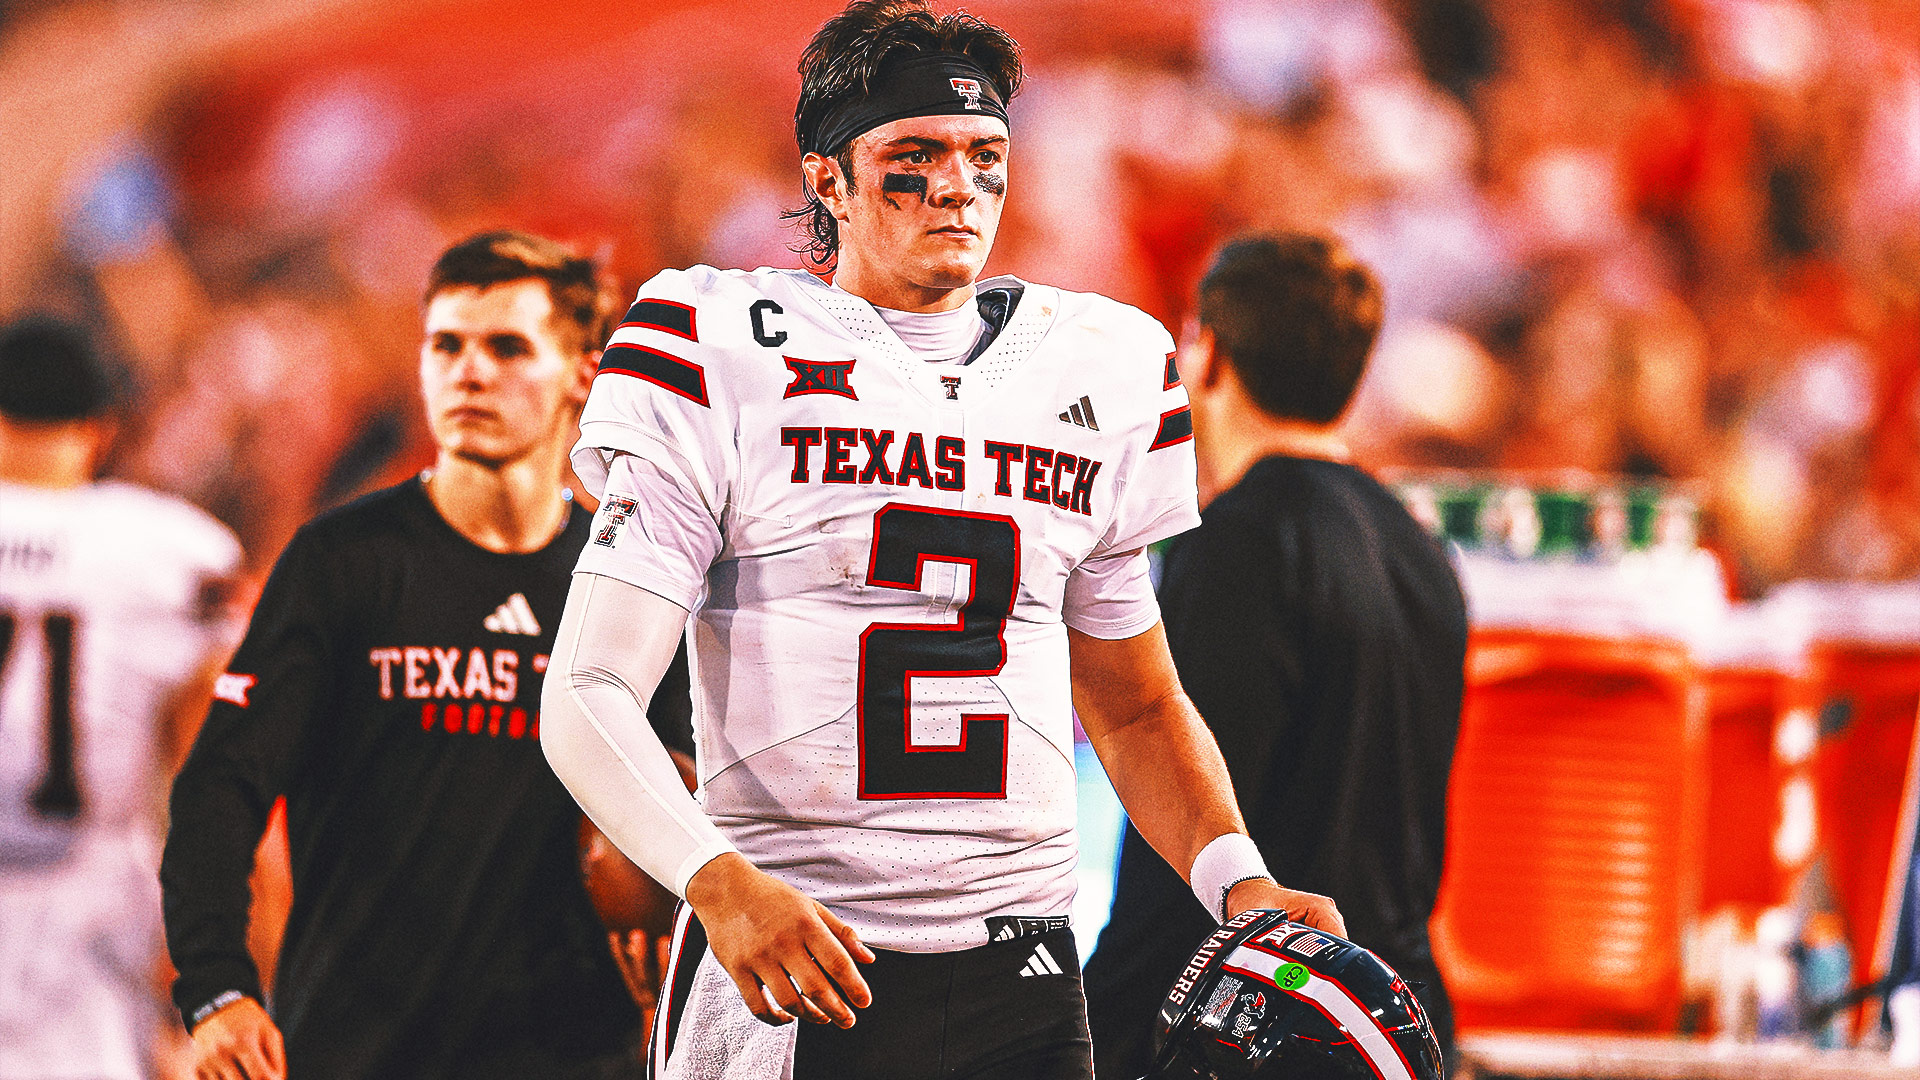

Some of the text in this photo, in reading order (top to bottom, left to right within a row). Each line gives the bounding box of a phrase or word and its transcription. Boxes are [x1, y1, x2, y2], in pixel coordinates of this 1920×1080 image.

[749, 299, 788, 347] C
[784, 357, 856, 398] XII
[781, 427, 1102, 516] TEXAS TECH
[369, 646, 519, 702] TEXAS
[857, 502, 1020, 800] 2
[1226, 910, 1267, 929] RED
[1168, 929, 1236, 1006] RAIDERS
[1285, 965, 1304, 988] C2P
